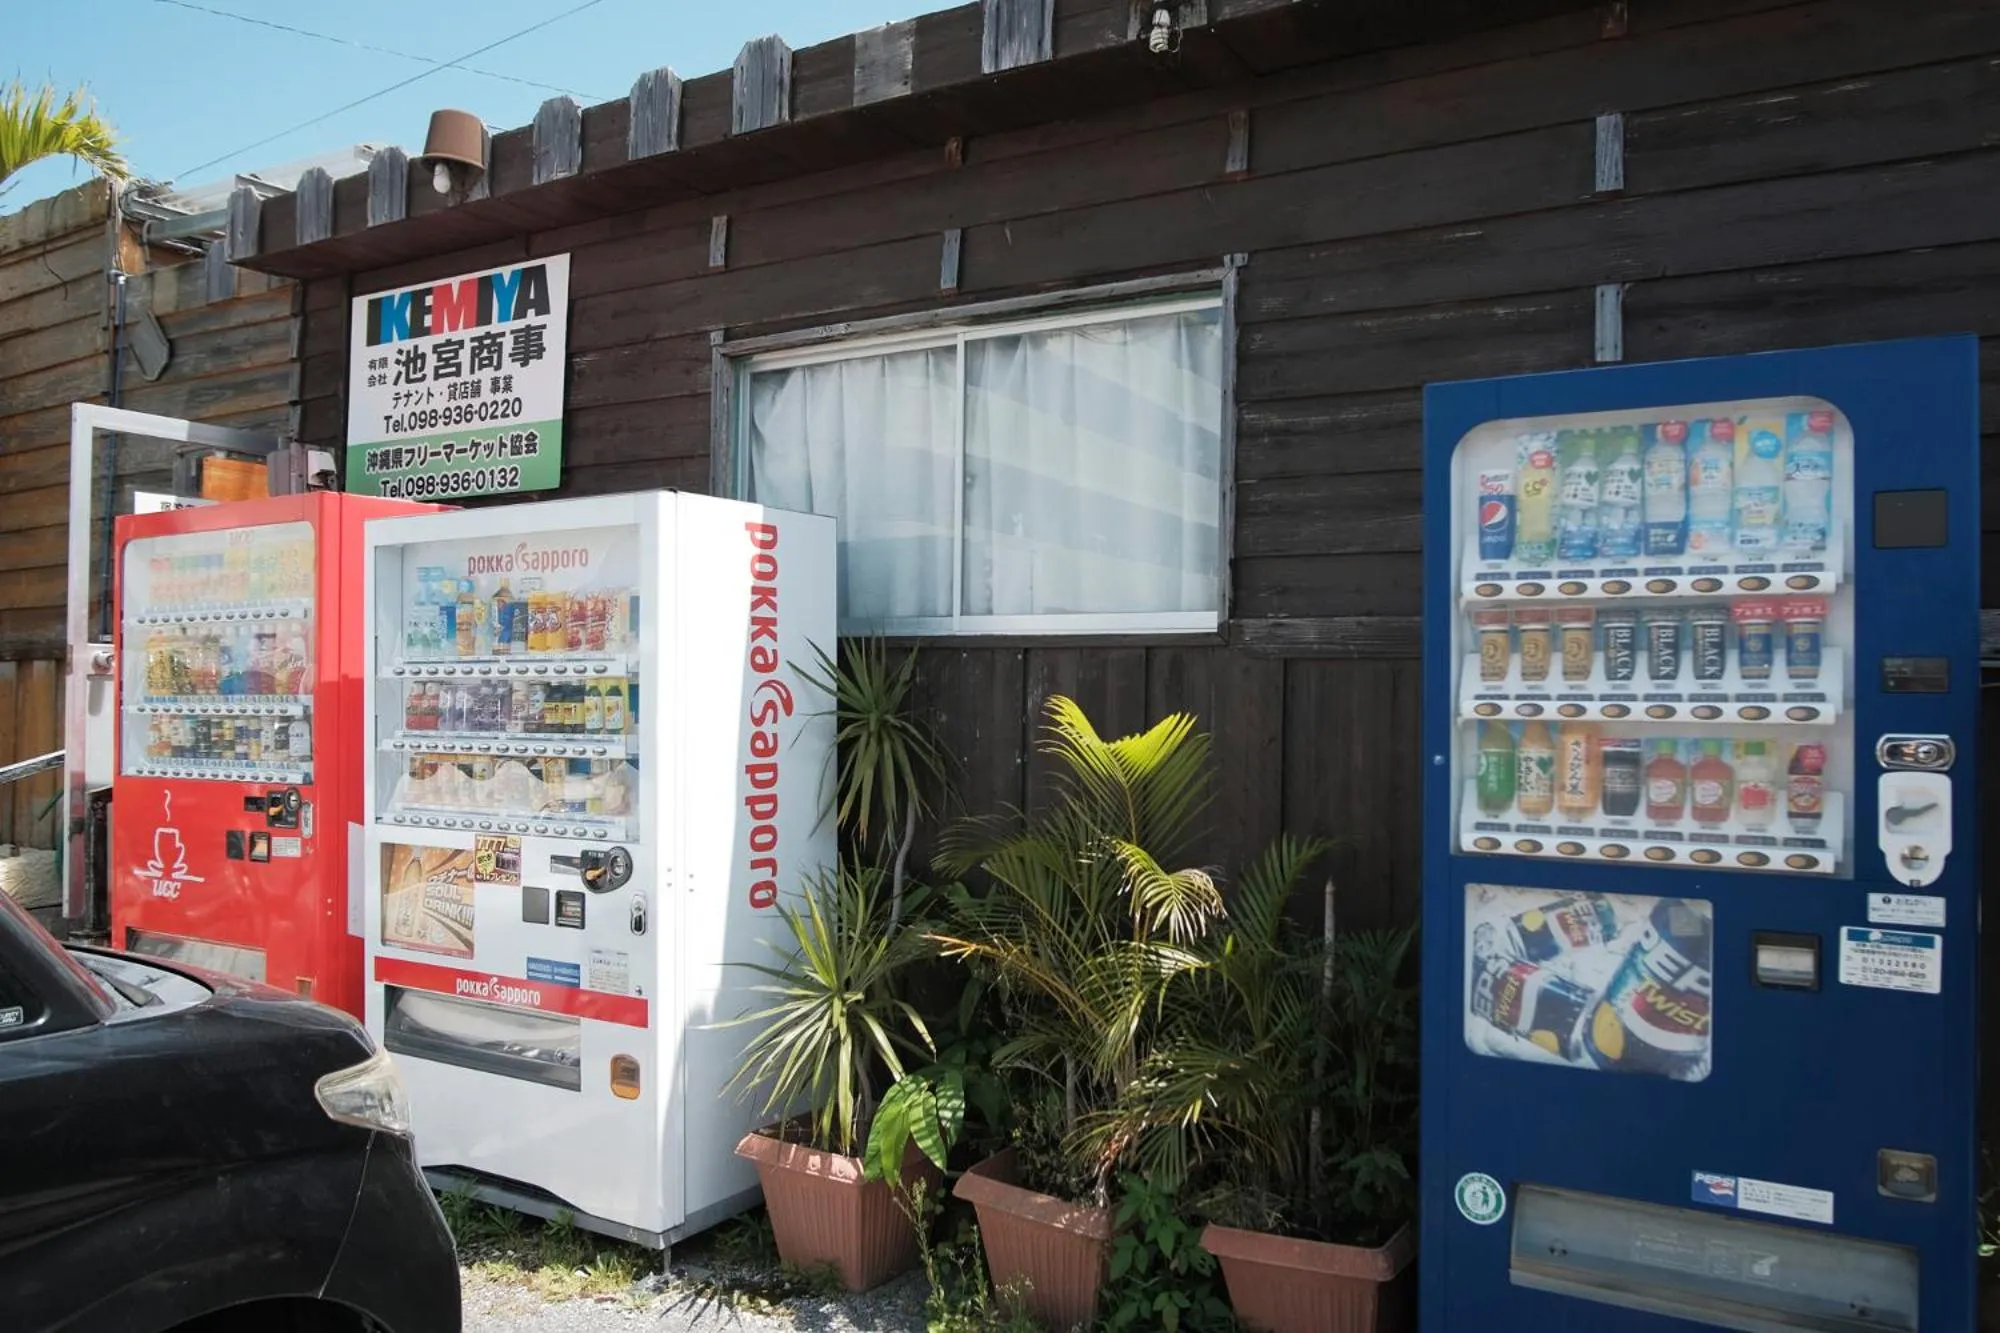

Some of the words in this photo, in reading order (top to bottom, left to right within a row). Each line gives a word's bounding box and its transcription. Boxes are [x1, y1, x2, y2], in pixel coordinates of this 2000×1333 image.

[366, 264, 551, 347] IKEMIYA
[392, 324, 547, 386] 池宮商事
[367, 373, 388, 387] 会社
[366, 431, 539, 472] 沖縄県フリーマーケット協会
[1616, 628, 1632, 679] BLACK
[1659, 628, 1675, 676] BLACK
[1704, 628, 1721, 676] BLACK
[152, 879, 182, 898] UCC
[425, 883, 462, 900] SOUL
